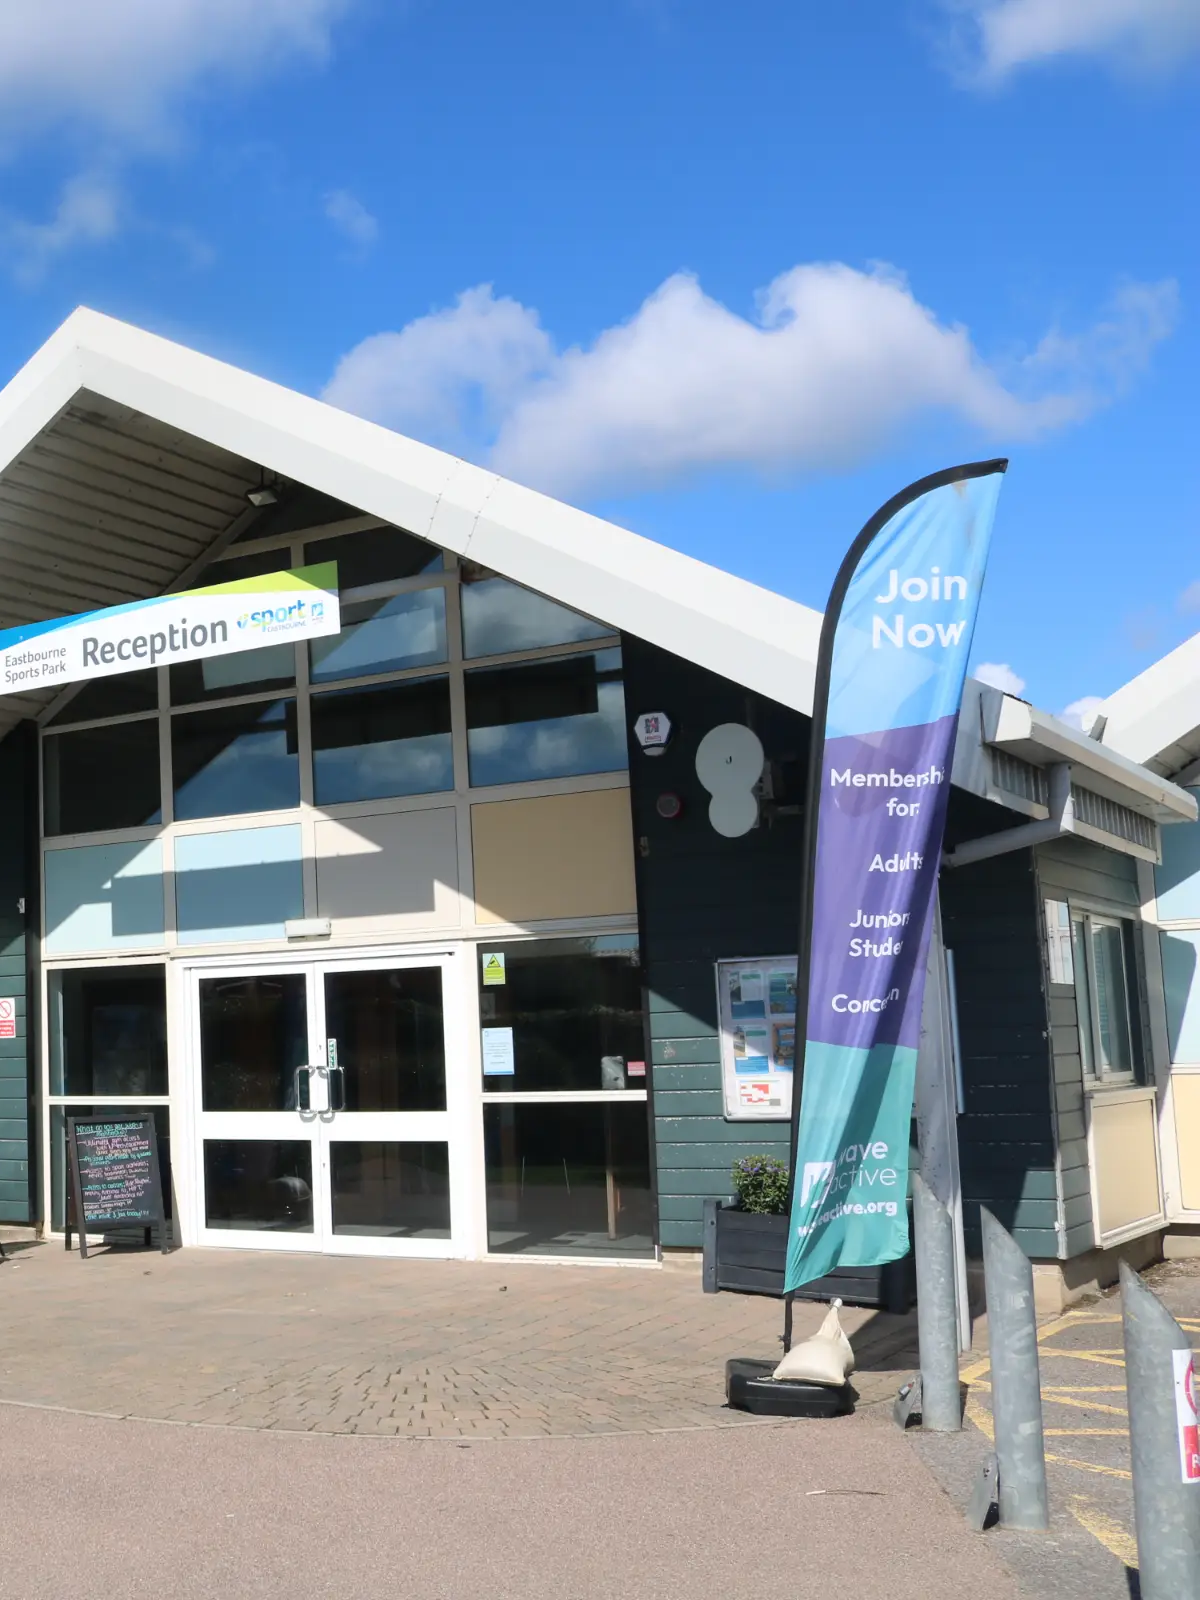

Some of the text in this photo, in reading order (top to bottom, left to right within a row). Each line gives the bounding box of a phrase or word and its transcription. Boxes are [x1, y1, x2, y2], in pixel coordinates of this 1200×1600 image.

[875, 566, 967, 603] Join
[251, 600, 306, 632] sport
[267, 620, 307, 632] EASTBOURNE
[82, 618, 228, 667] Reception
[873, 614, 967, 649] Now
[5, 647, 67, 667] Eastbourne
[5, 660, 66, 684] Sports Park
[849, 937, 903, 957] Stude
